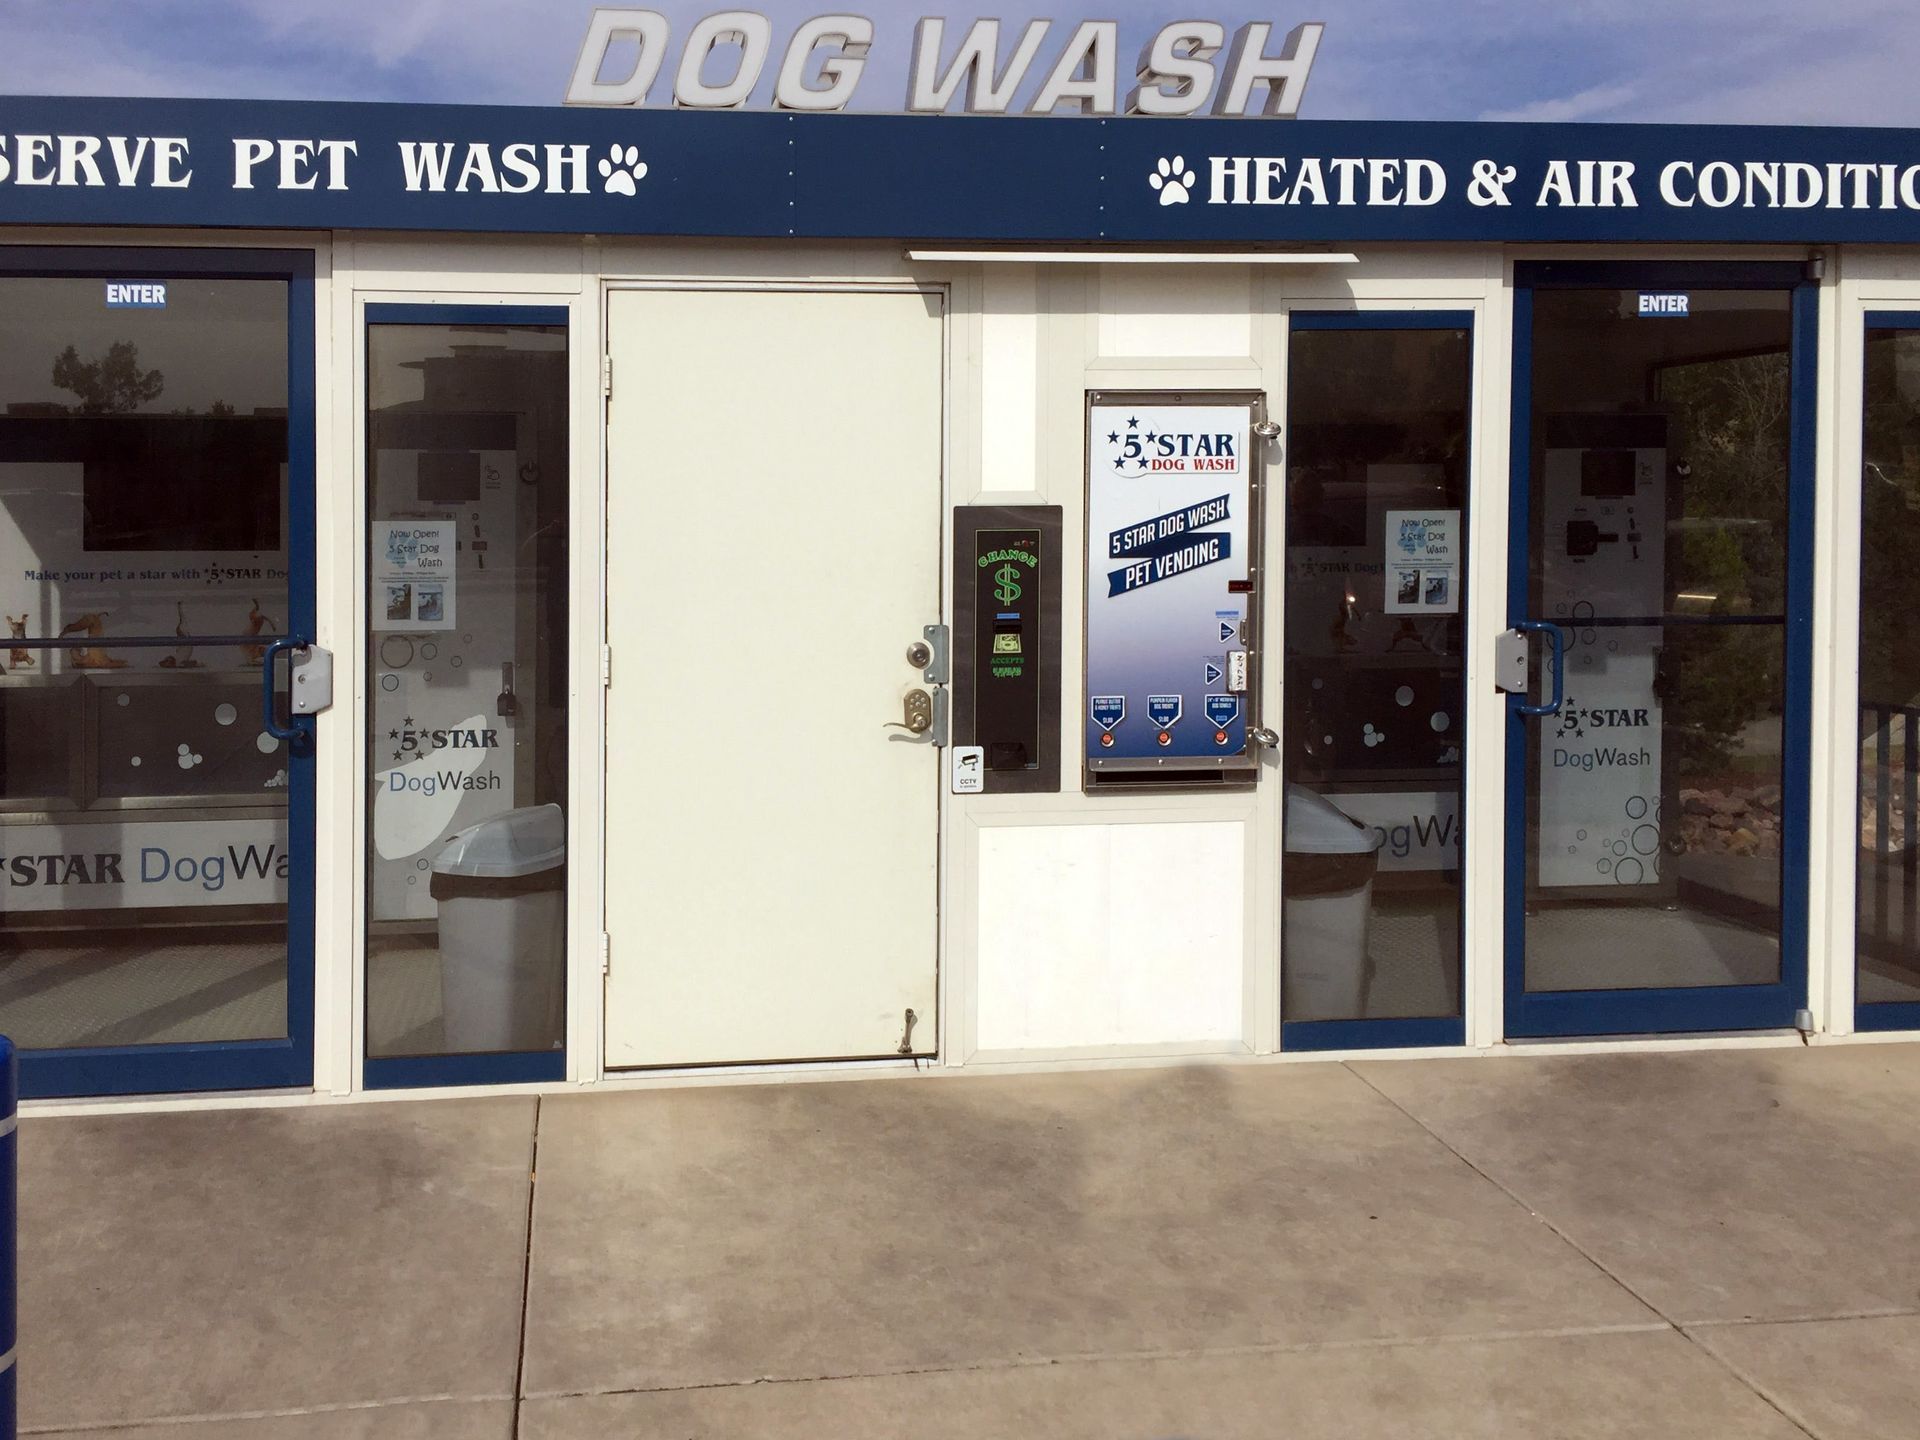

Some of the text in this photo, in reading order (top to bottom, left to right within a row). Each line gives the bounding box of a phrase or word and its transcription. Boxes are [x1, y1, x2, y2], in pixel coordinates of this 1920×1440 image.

[563, 9, 1325, 117] DOG WASH
[232, 139, 357, 190] PET
[398, 142, 591, 194] WASH
[1207, 156, 1448, 207] HEATED
[1466, 159, 1517, 208] &
[1536, 160, 1638, 208] AIR
[107, 284, 165, 303] ENTER
[1639, 295, 1688, 312] ENTER
[1123, 434, 1234, 458] 5 STAR
[1151, 458, 1235, 471] DOG WASH
[1113, 499, 1225, 554] 5 STAR DOG WASH
[1402, 519, 1445, 529] Now Open!
[390, 529, 439, 540] Now Open!
[1408, 533, 1425, 542] Star
[1428, 532, 1445, 542] Dog
[397, 544, 417, 554] Star
[420, 544, 439, 554] Dog
[978, 549, 1038, 568] CHANGE
[1426, 546, 1448, 555] Wash
[418, 558, 443, 568] Wash
[1125, 538, 1219, 590] PET VENDING
[1320, 563, 1350, 573] STAR
[24, 570, 61, 581] Make
[64, 571, 94, 583] your
[100, 570, 122, 583] pet
[127, 571, 135, 580] a
[139, 569, 166, 580] star
[171, 568, 199, 579] with
[209, 569, 219, 580] 5
[226, 568, 262, 579] STAR
[1563, 709, 1649, 729] 5 STAR
[401, 729, 499, 750] 5 STAR
[1554, 747, 1650, 772] DogWash
[390, 771, 501, 796] DogWash
[10, 853, 125, 886] STAR
